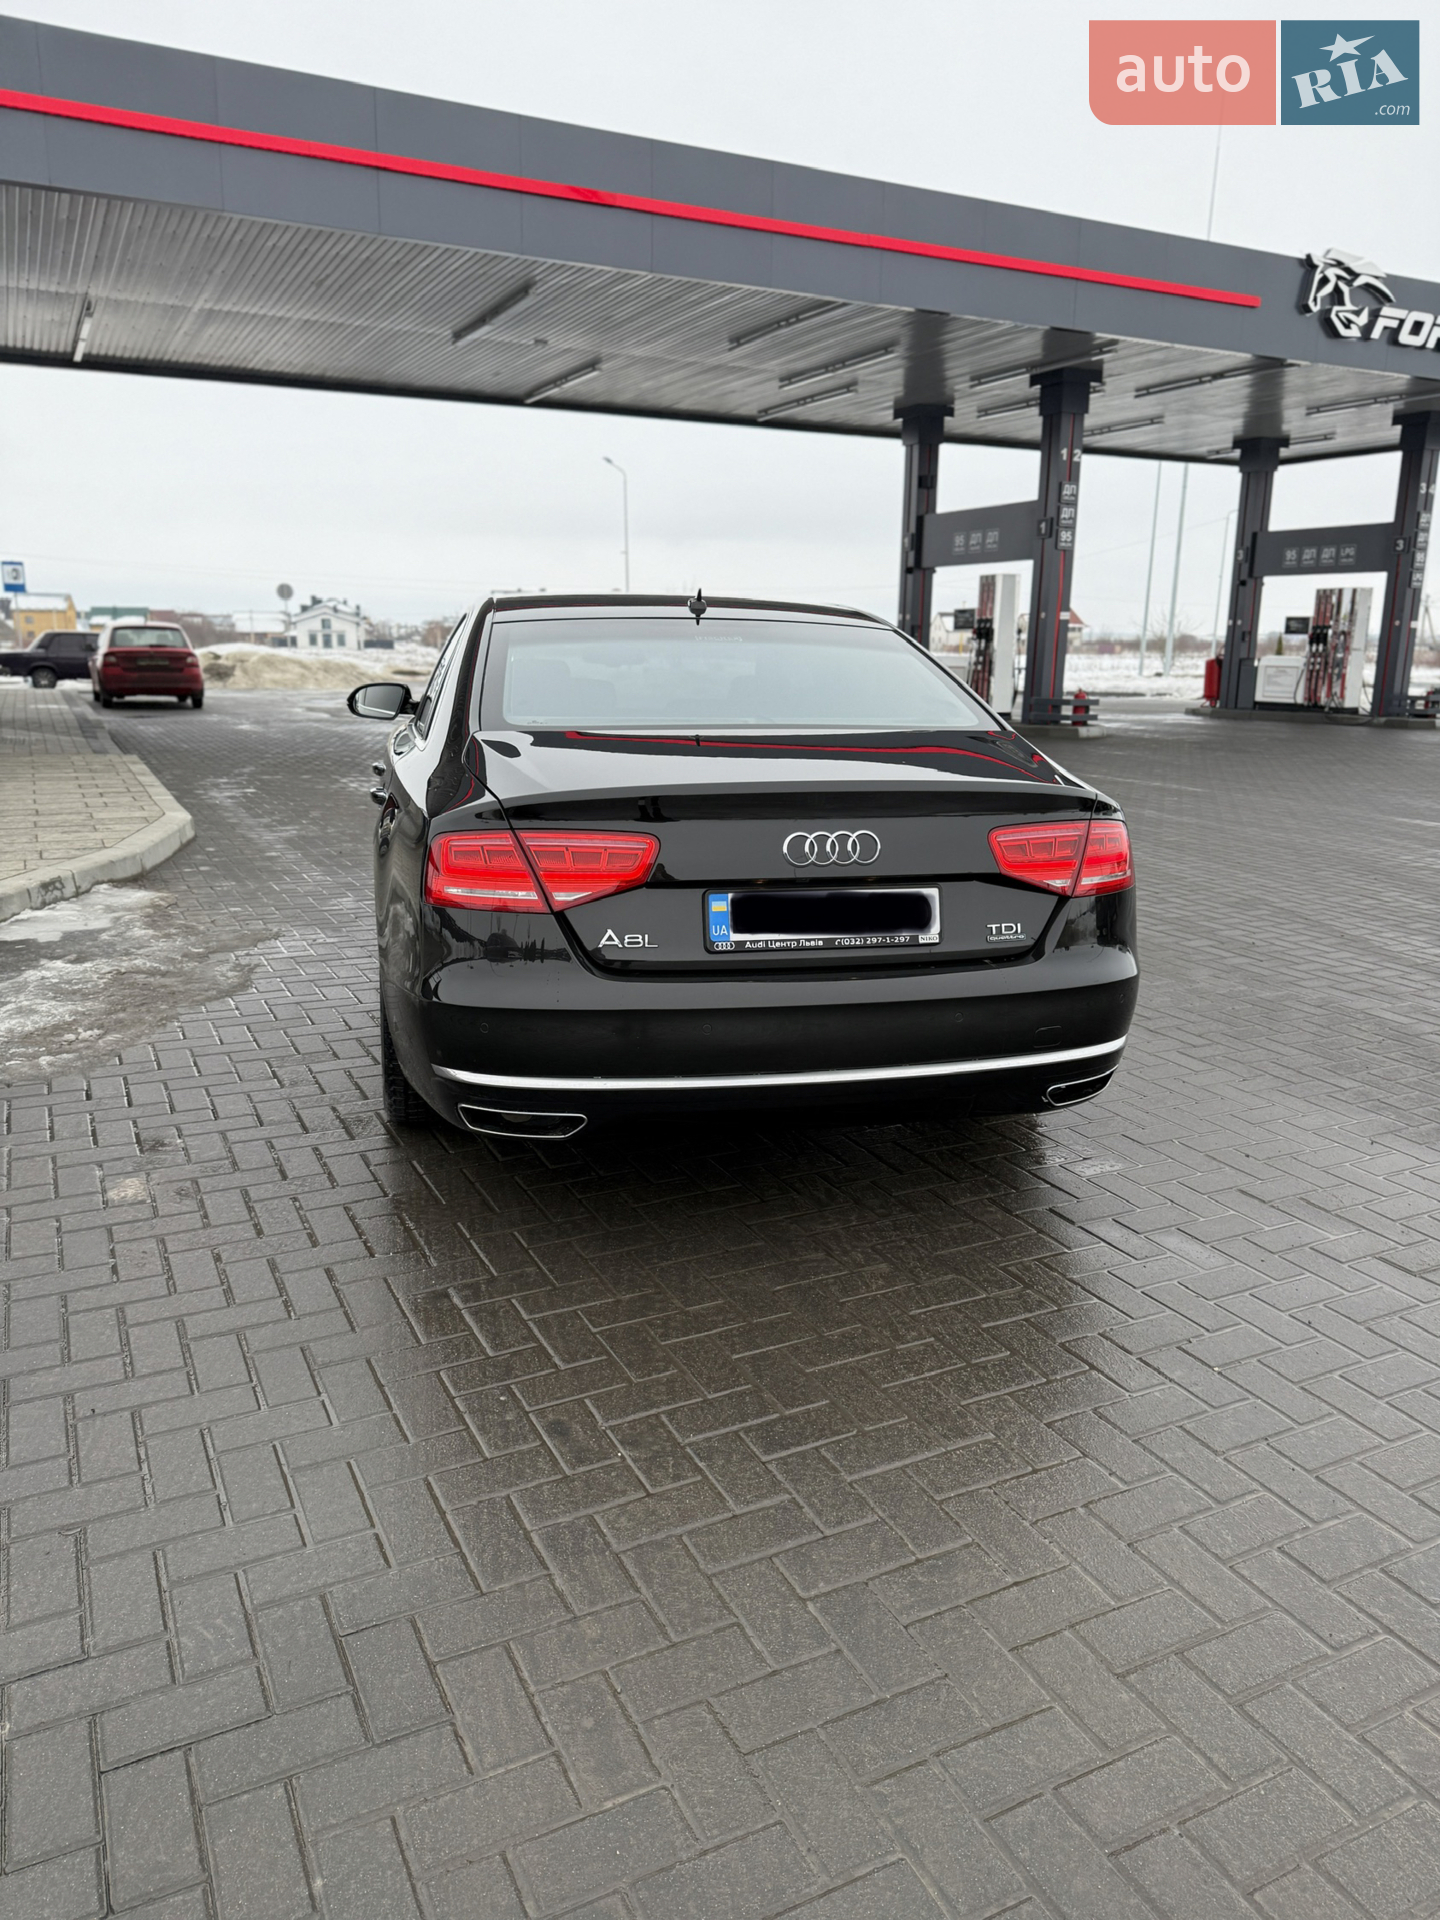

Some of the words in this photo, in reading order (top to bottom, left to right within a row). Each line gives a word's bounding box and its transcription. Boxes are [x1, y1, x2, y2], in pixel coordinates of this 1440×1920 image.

[1061, 448, 1068, 461] 1
[1073, 449, 1081, 461] 2
[1062, 484, 1077, 496] ДП
[1420, 483, 1427, 494] 3
[1061, 507, 1075, 519] ДП
[1040, 521, 1046, 534] 1
[954, 534, 964, 546] 95
[1060, 531, 1072, 542] 95
[1395, 539, 1404, 551] 3
[1285, 549, 1297, 561] 95
[712, 925, 728, 936] UA
[986, 923, 1021, 935] TDI
[598, 929, 658, 948] A8L
[745, 940, 766, 948] Audi
[768, 940, 797, 949] Центр
[799, 939, 824, 947] Львів
[841, 937, 864, 945] (032)
[866, 936, 911, 945] 297-1-297
